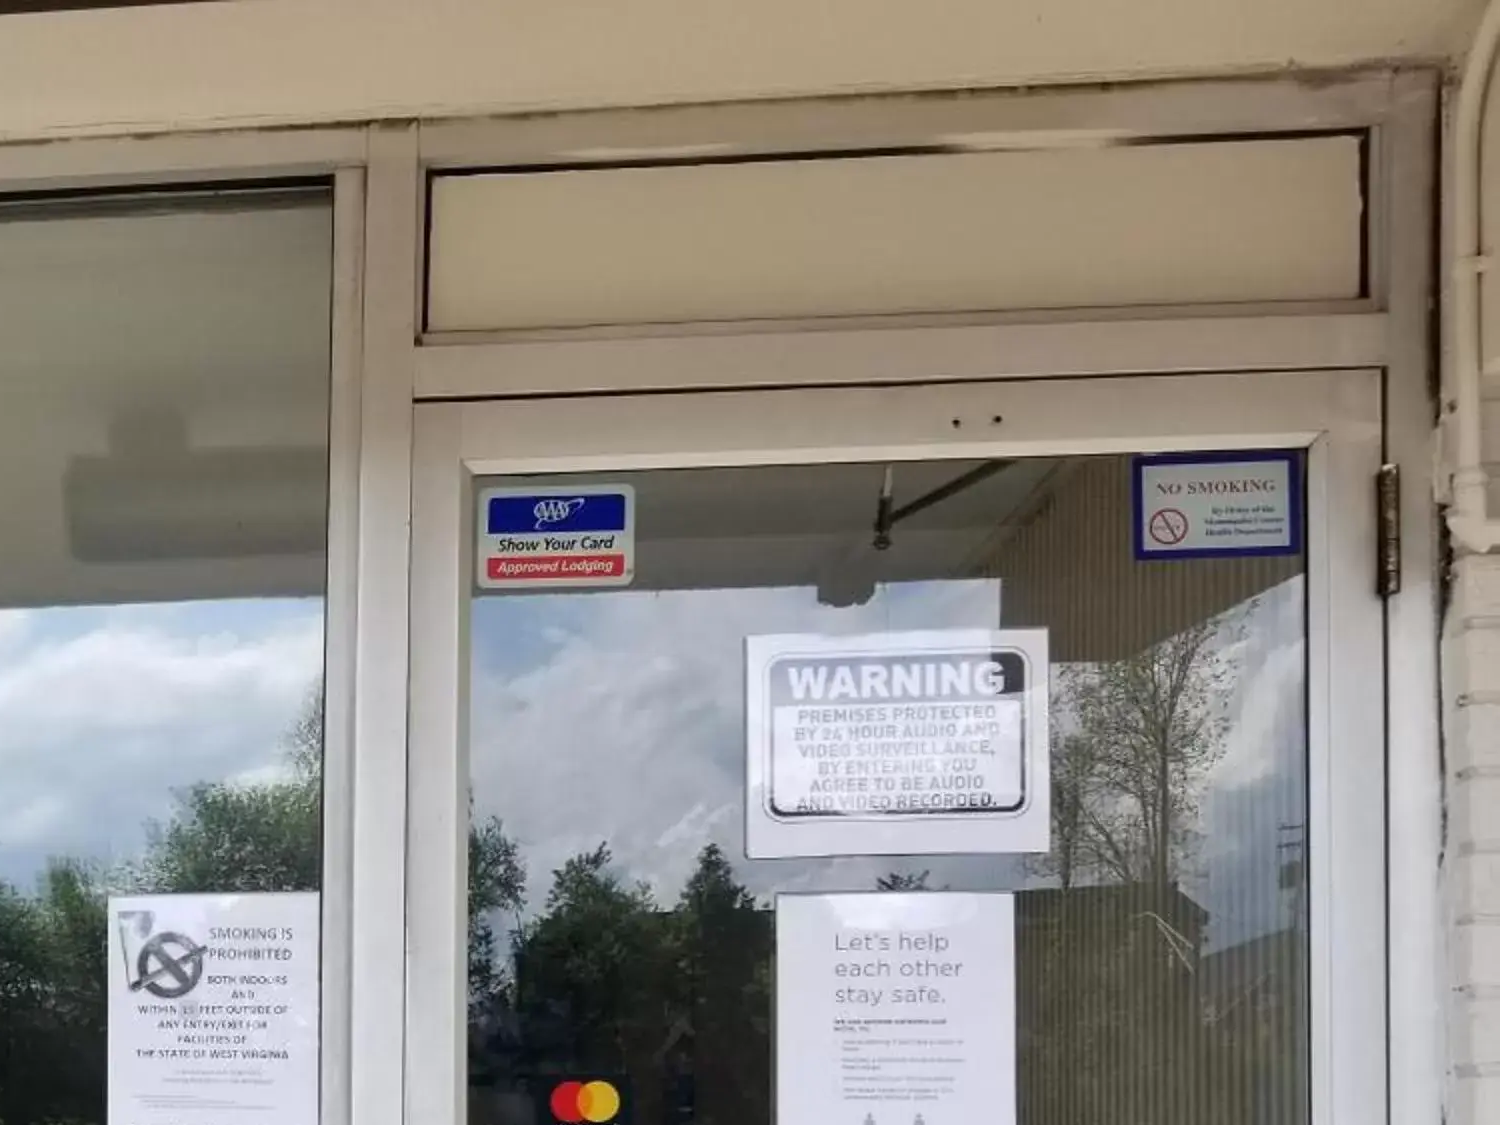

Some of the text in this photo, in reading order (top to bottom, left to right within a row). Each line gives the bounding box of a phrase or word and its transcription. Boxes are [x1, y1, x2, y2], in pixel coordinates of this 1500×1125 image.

[1156, 478, 1276, 496] NO SMOKING
[499, 535, 615, 552] Show Your Card
[498, 560, 613, 575] Approved Lodging
[788, 661, 1004, 699] WARNING
[798, 705, 996, 725] PREMISES PROTECTED
[794, 727, 816, 741] BY
[848, 724, 897, 740] HOUR
[903, 722, 958, 737] AUDIO
[962, 721, 1000, 737] AND
[798, 743, 851, 759] VIDEO
[818, 757, 978, 775] BY ENTERING YOU
[810, 774, 984, 793] AGREE TO BE AUDIO
[896, 792, 997, 809] RECORDED.
[209, 927, 293, 940] SMOKING IS
[835, 932, 949, 952] Let's help
[209, 947, 293, 961] PROHIBITED
[835, 960, 963, 977] each other
[207, 975, 236, 985] BOTH
[231, 989, 255, 1000] AND
[835, 985, 946, 1007] stay safe.
[137, 1004, 177, 1015] WITHIN
[209, 1049, 238, 1060] WEST
